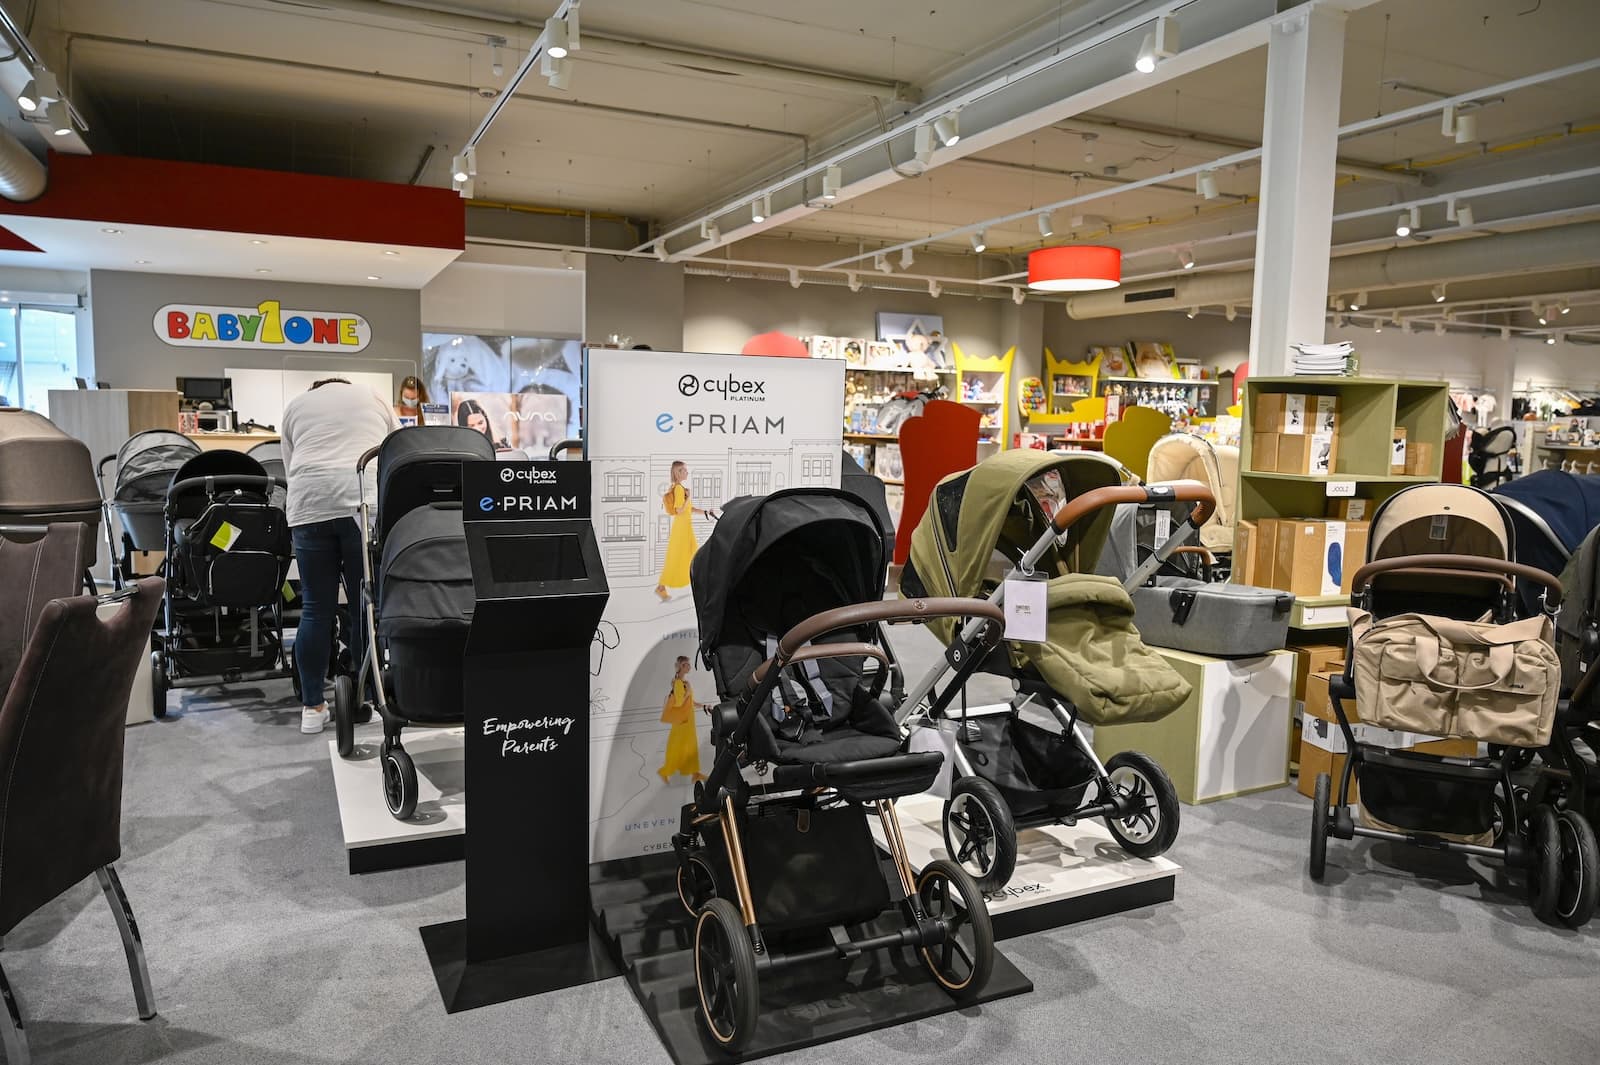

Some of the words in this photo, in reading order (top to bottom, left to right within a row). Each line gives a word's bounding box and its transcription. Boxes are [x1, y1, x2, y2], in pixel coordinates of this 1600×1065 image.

[703, 373, 765, 400] cybex
[503, 411, 557, 422] nuna
[516, 466, 556, 484] cybex
[483, 717, 575, 739] Empowering
[502, 736, 558, 757] Parents
[625, 817, 675, 831] UNEVEN
